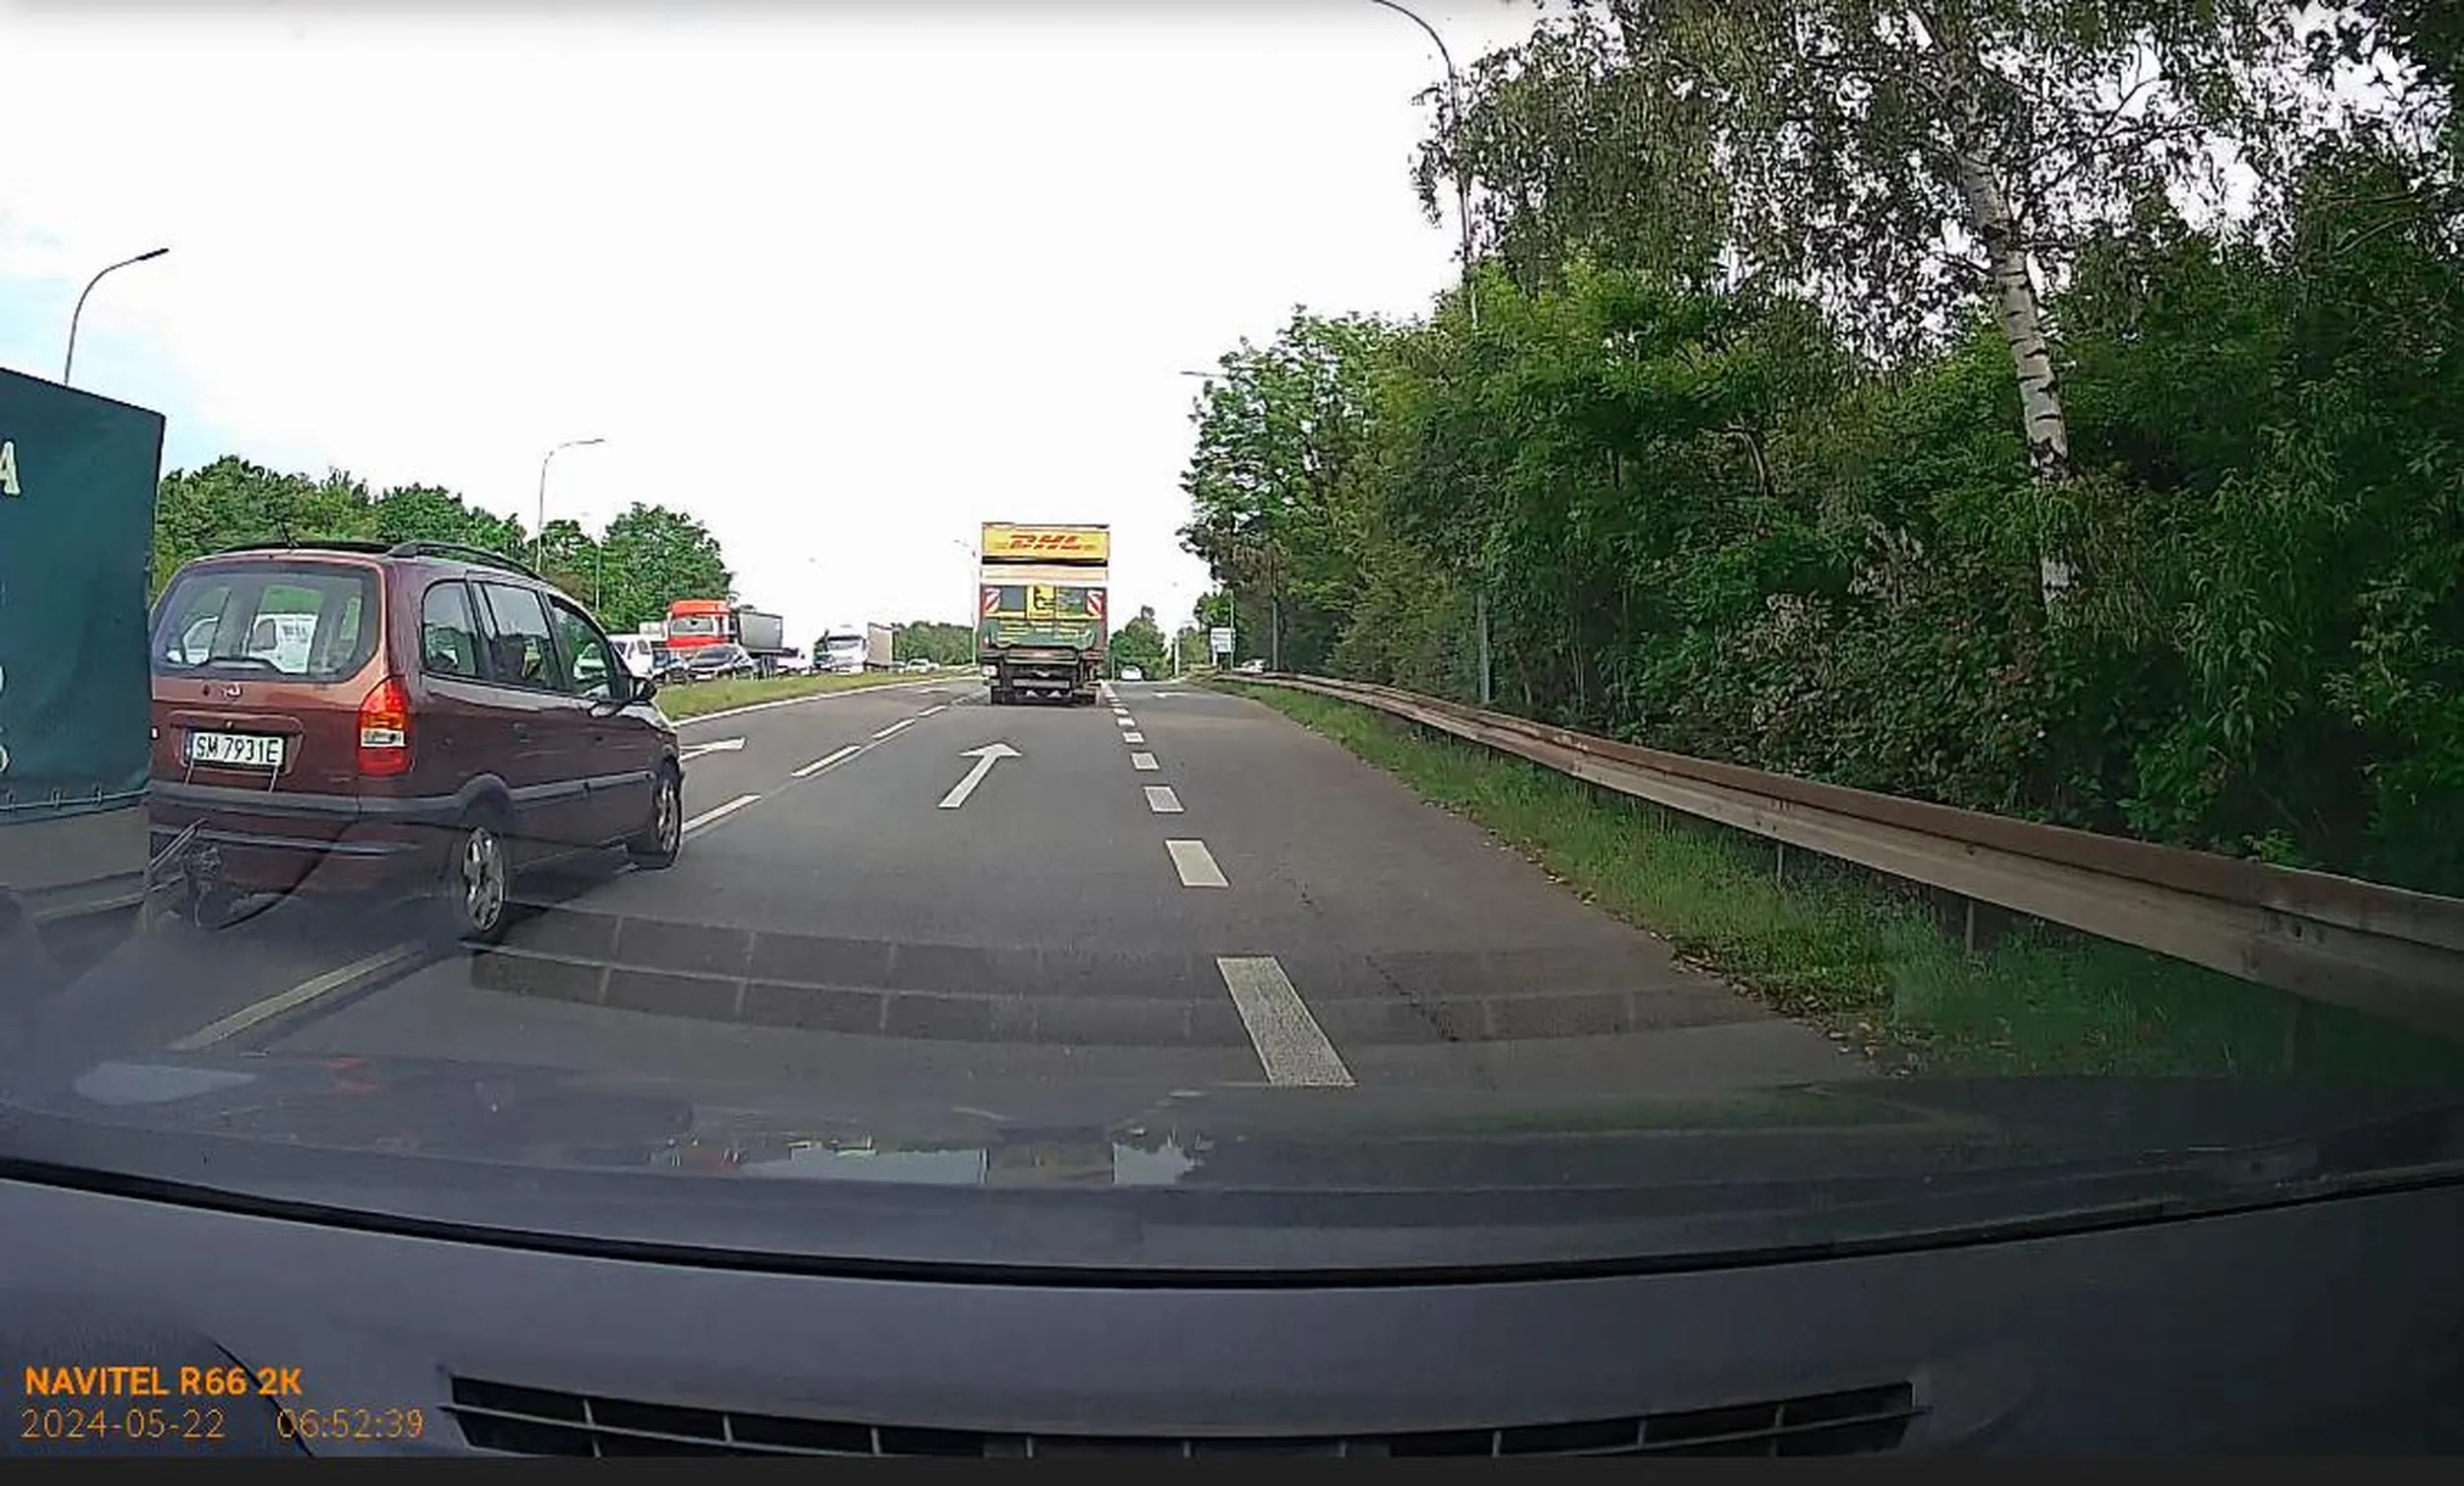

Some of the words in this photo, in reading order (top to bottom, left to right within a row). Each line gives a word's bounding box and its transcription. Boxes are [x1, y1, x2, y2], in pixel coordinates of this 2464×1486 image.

[1008, 534, 1082, 550] DHL
[196, 735, 218, 759] SM
[224, 737, 279, 763] 7931E
